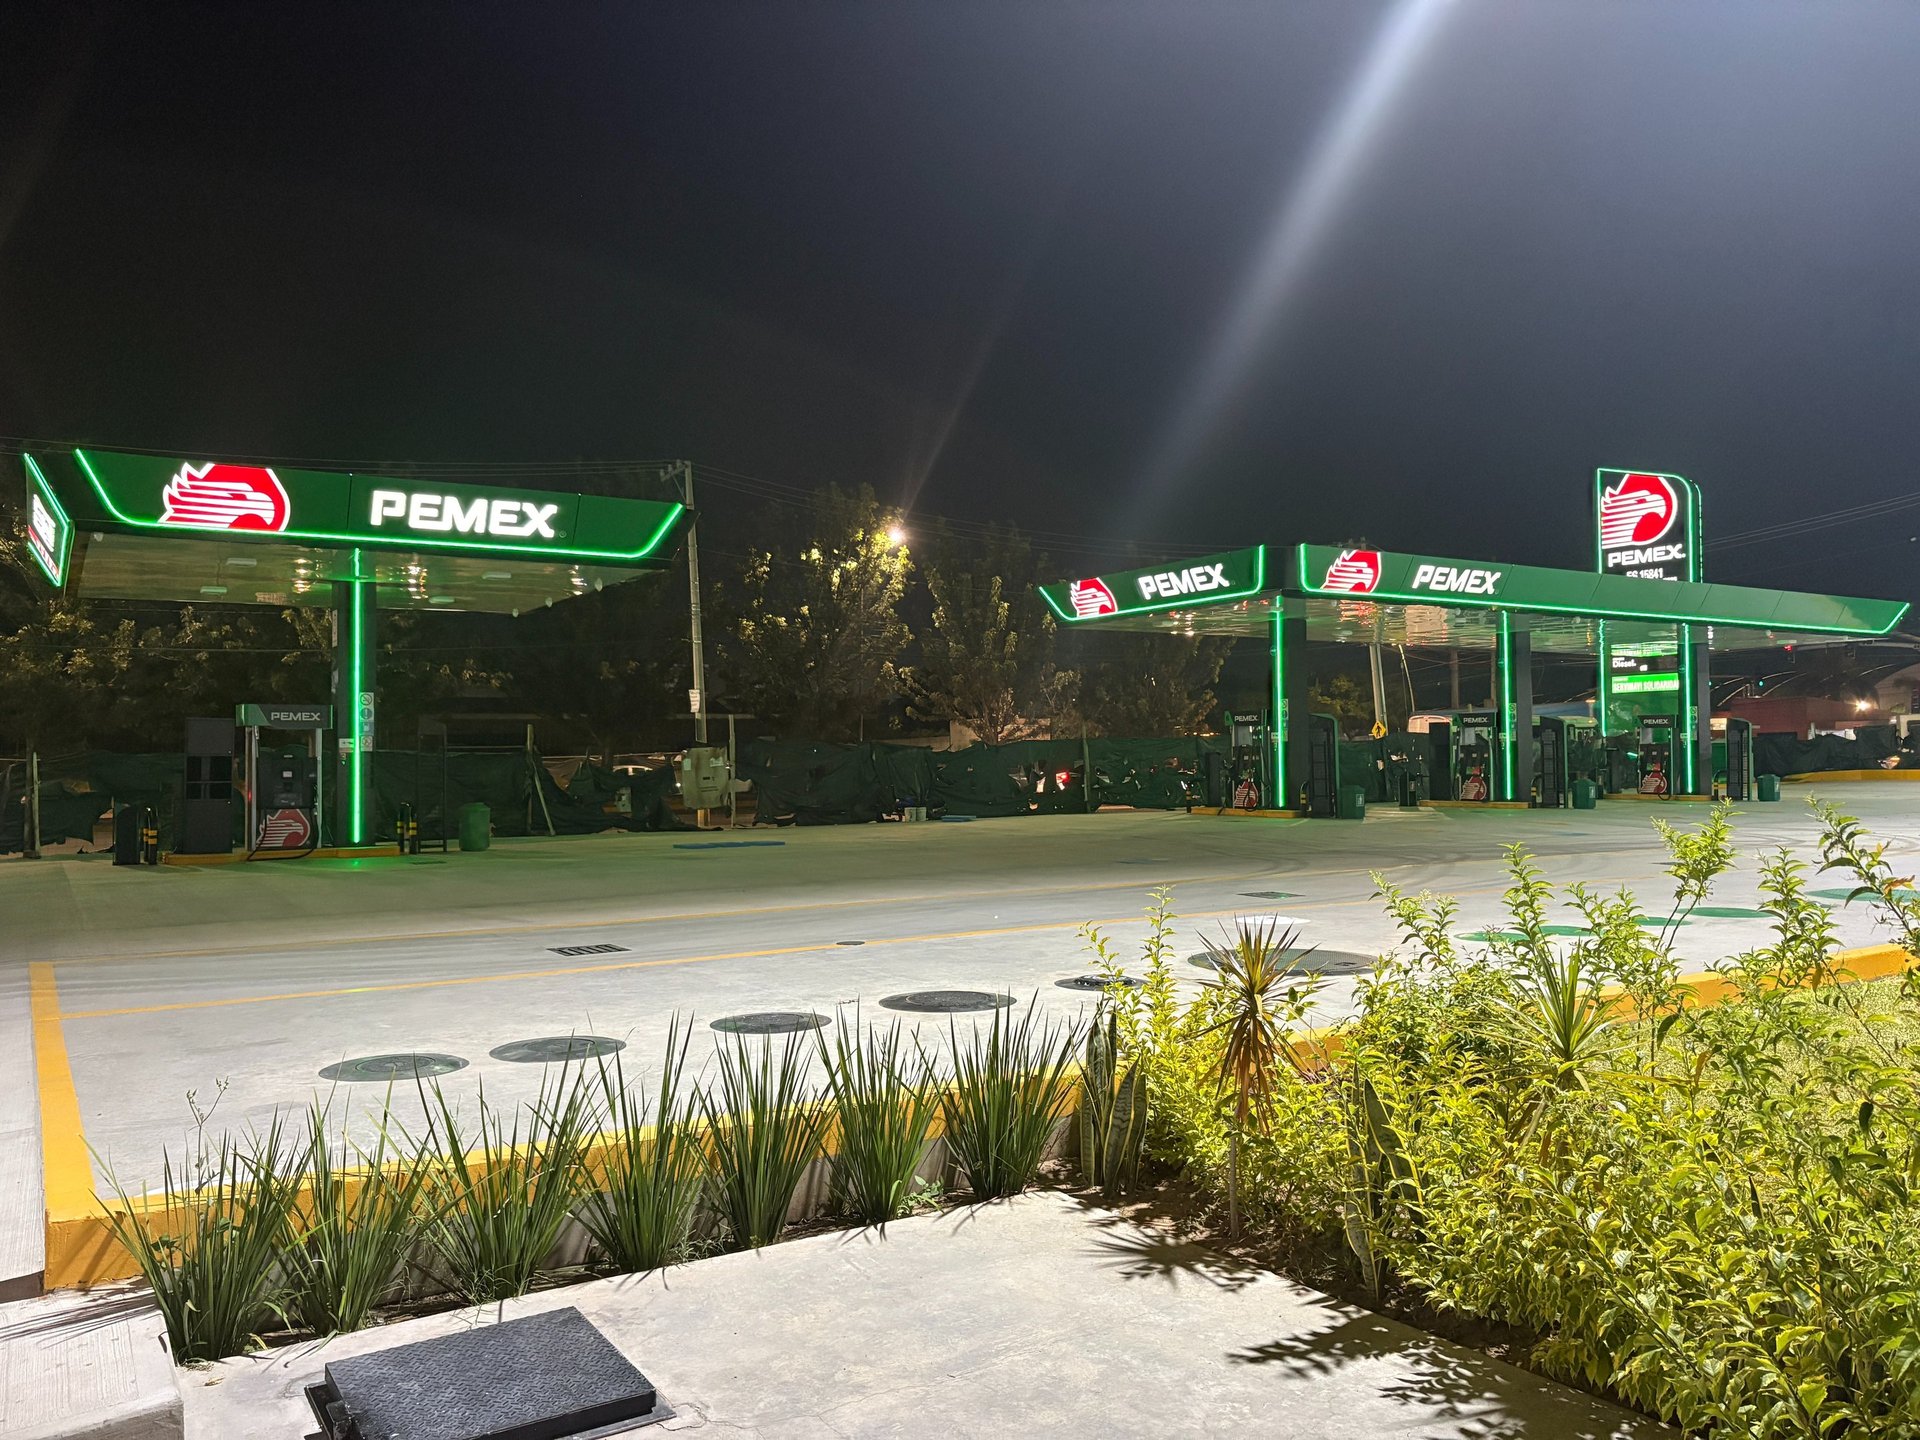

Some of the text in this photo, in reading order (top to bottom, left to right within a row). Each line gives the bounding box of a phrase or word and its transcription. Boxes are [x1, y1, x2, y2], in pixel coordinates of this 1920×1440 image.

[370, 490, 558, 538] PEMEX
[1608, 543, 1684, 567] PEMEX
[1138, 562, 1230, 600] PEMEX
[1411, 564, 1502, 595] PEMEX
[270, 711, 321, 721] PEMEX
[1234, 714, 1259, 722] PEMEX
